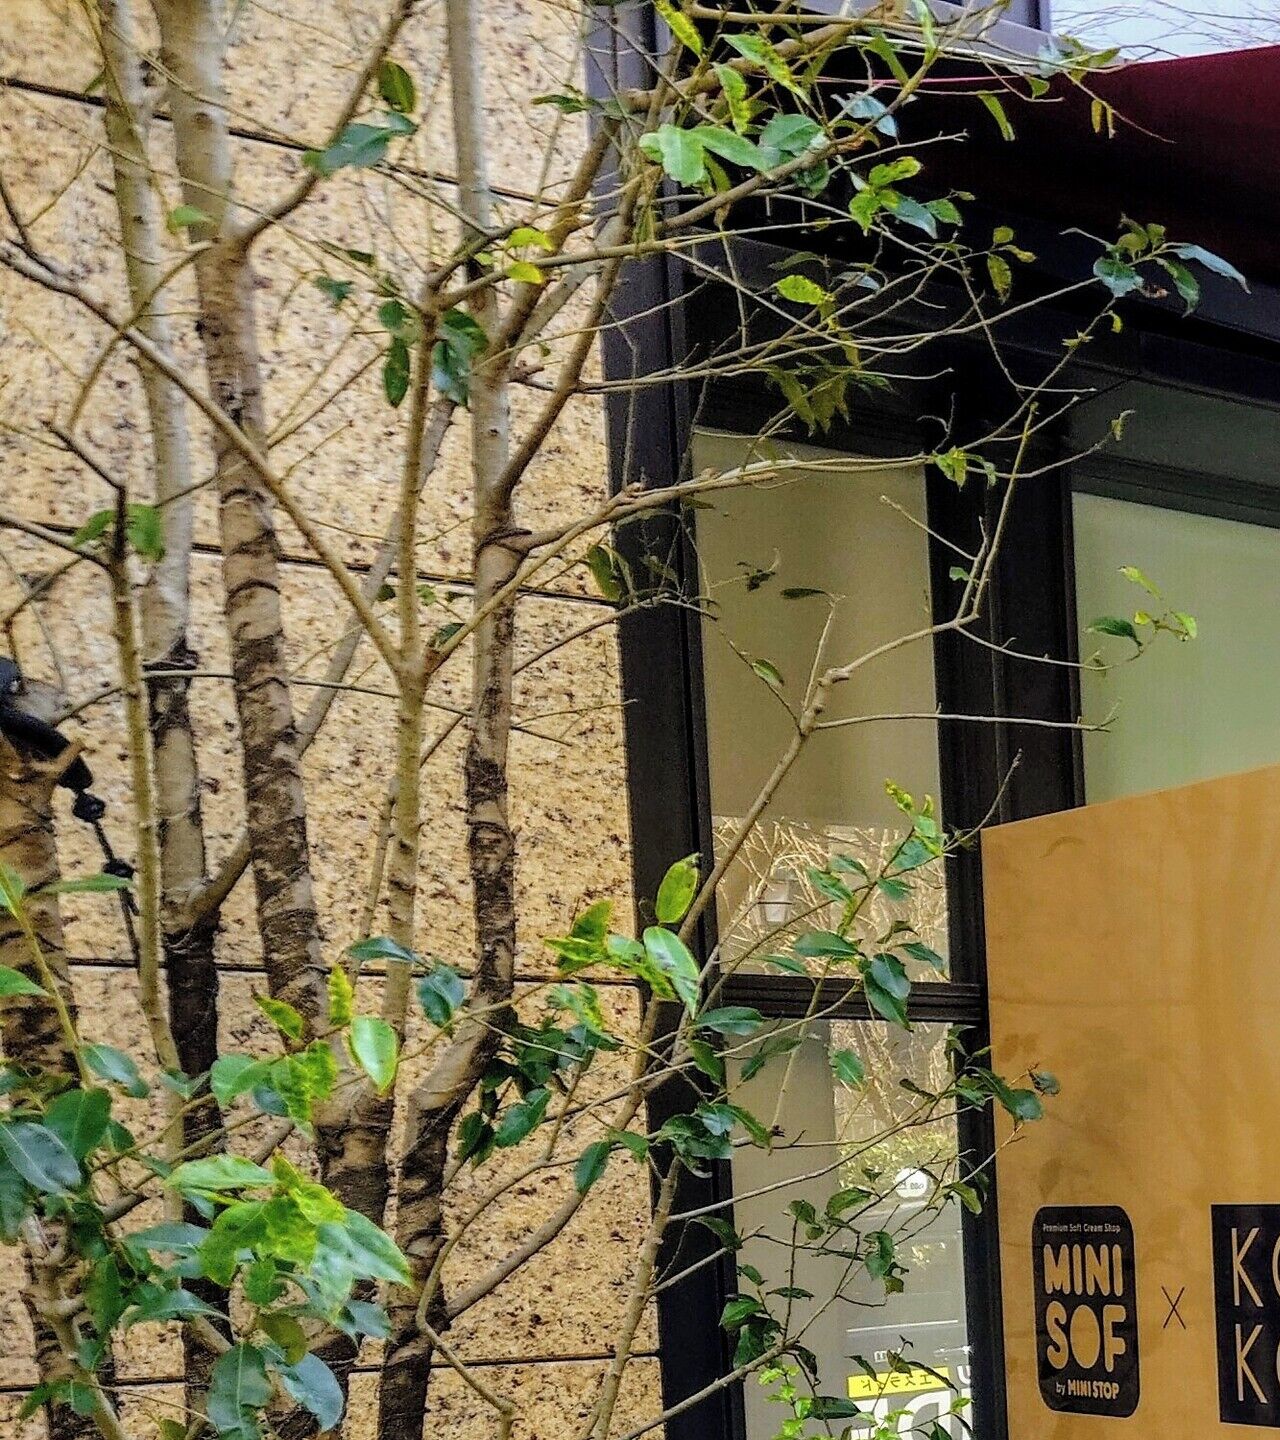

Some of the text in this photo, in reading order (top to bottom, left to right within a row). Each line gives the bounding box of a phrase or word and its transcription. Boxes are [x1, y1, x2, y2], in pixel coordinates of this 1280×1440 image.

[1043, 1243, 1123, 1296] MINI
[1046, 1301, 1126, 1372] SOF
[1056, 1382, 1066, 1396] by
